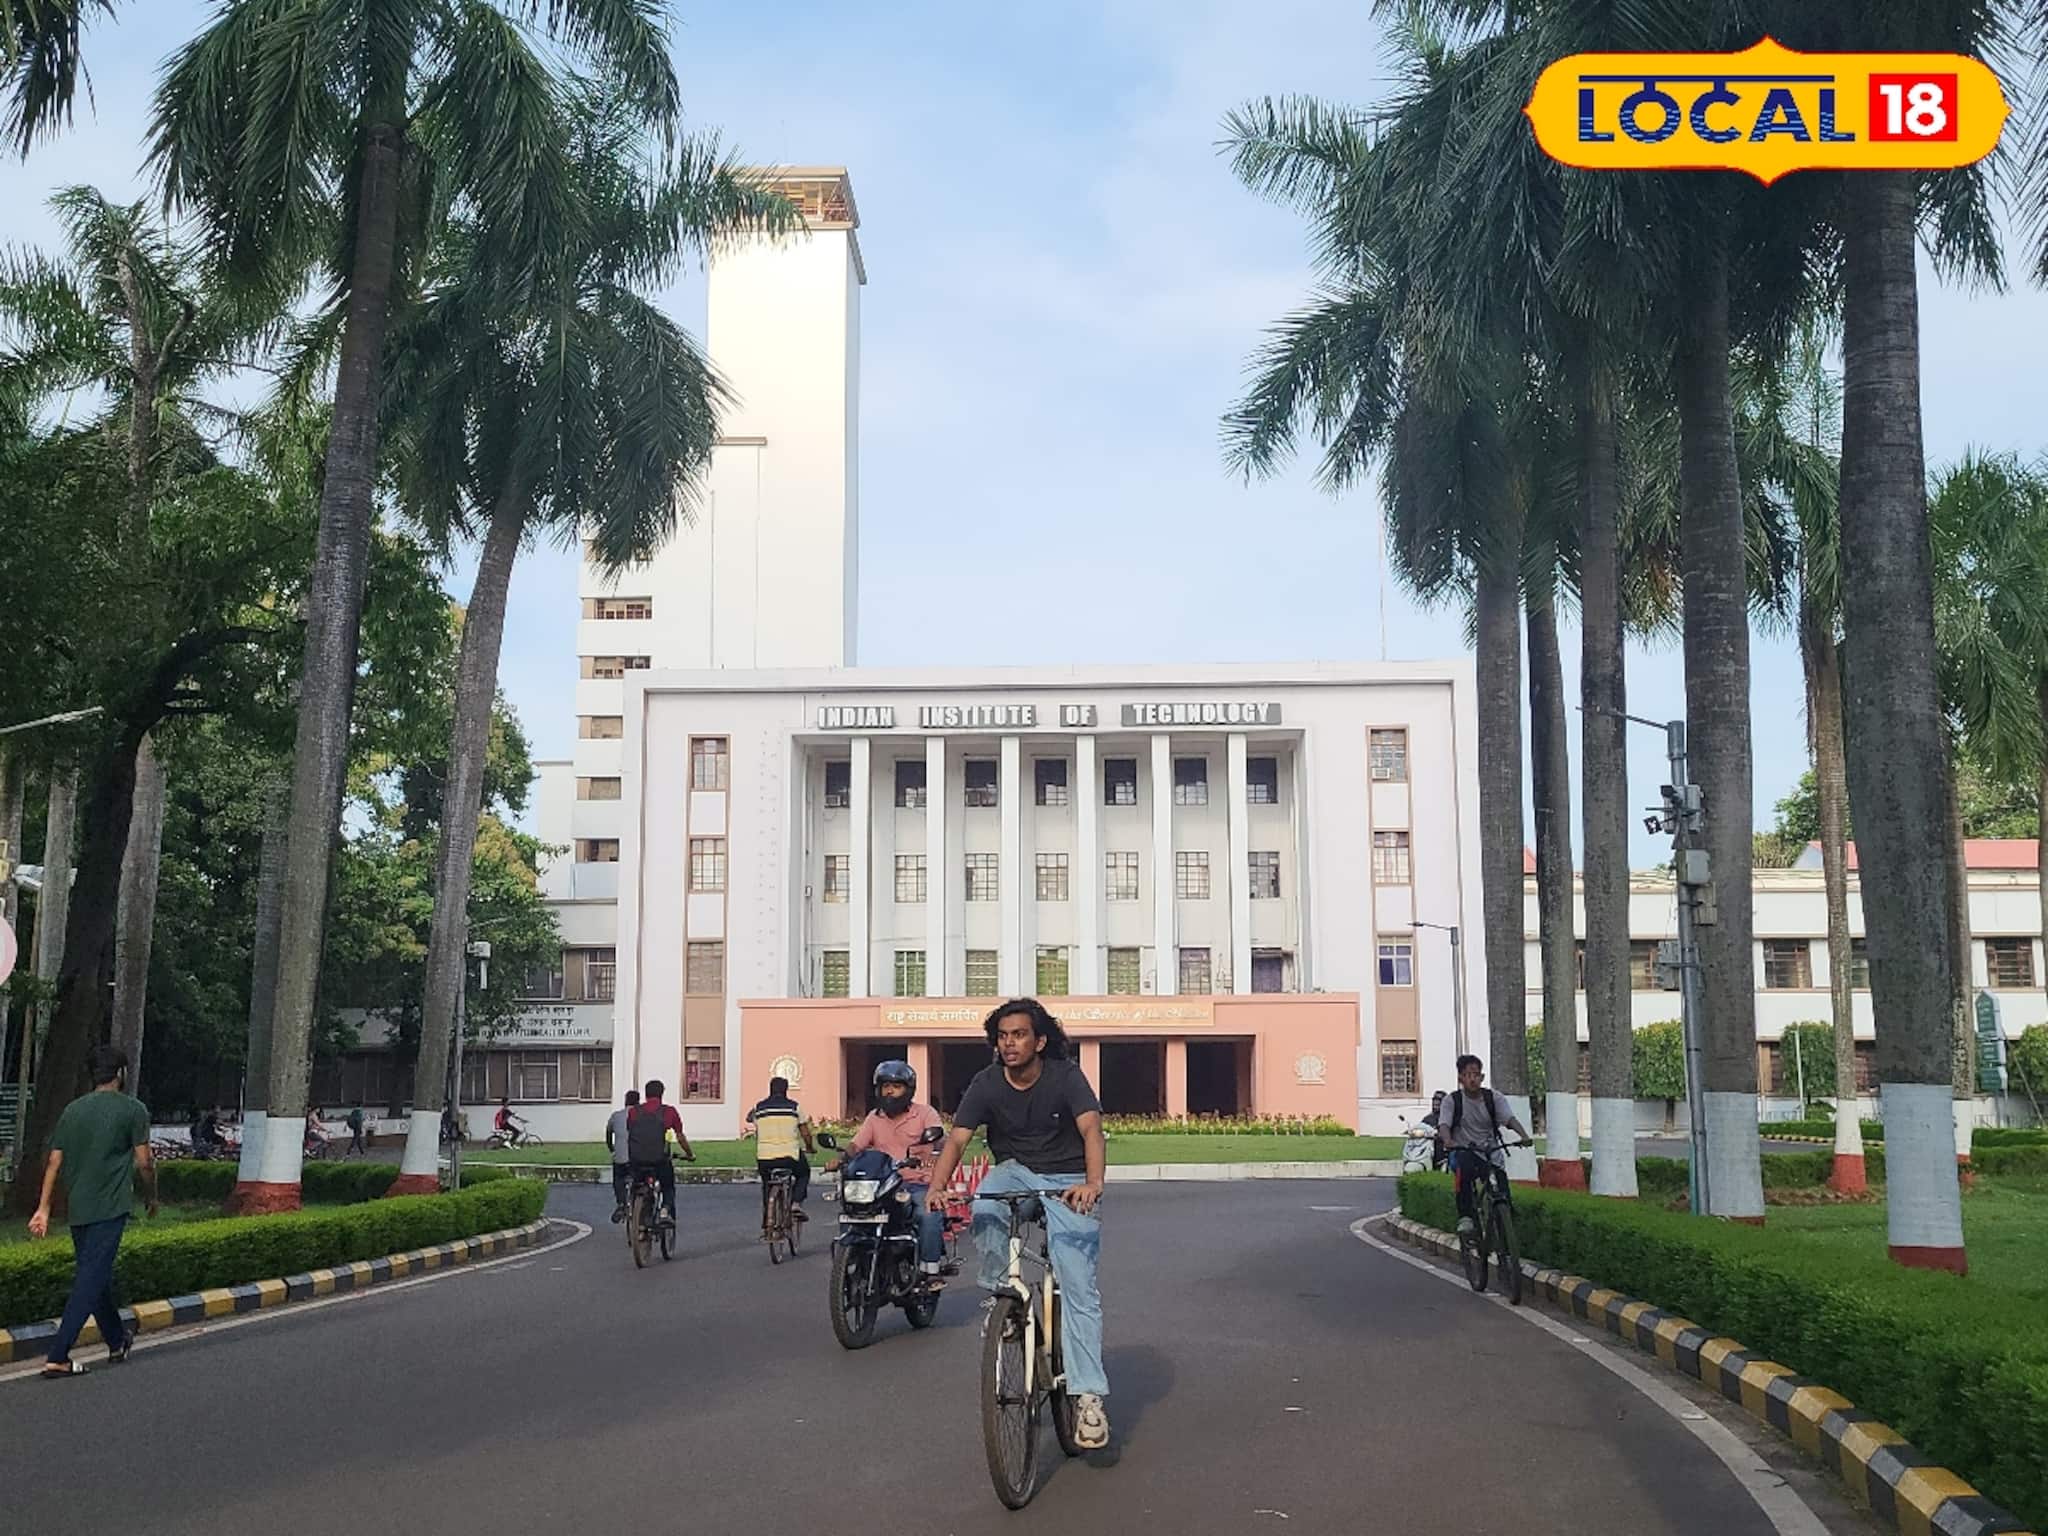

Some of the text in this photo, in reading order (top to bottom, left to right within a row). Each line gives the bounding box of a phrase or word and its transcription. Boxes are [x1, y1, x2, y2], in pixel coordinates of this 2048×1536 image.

[818, 703, 1270, 728] INDIAN INSTITUTE OF TECHNOLOGY
